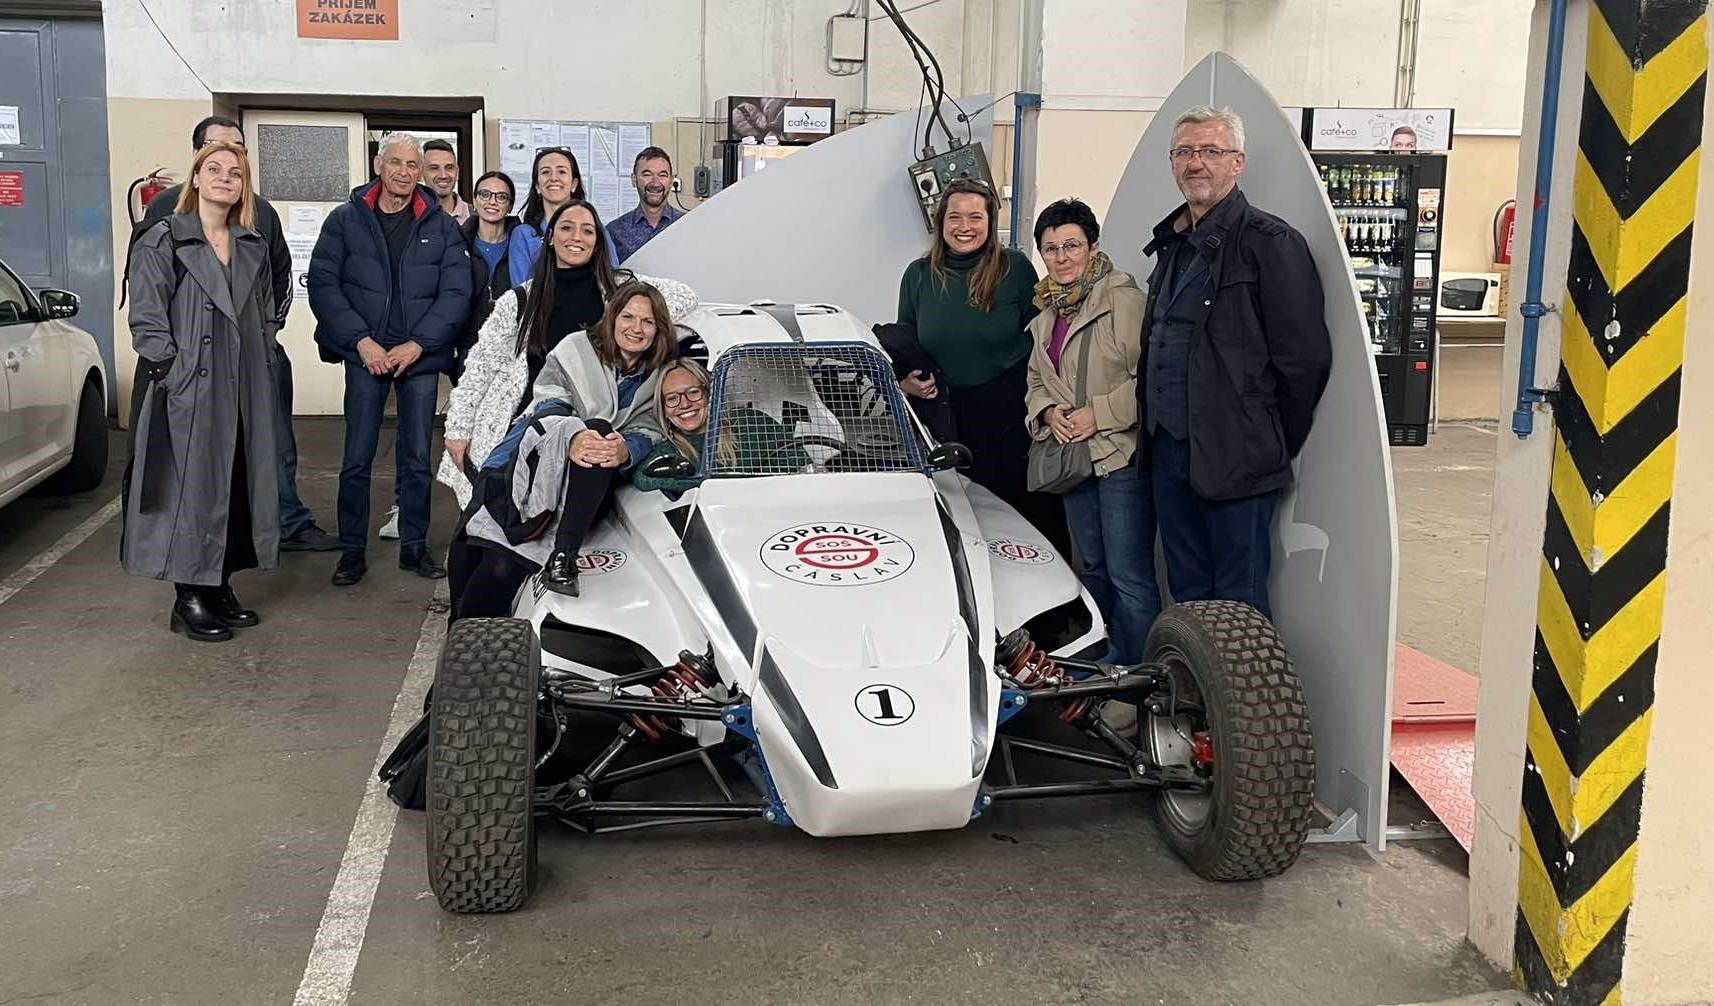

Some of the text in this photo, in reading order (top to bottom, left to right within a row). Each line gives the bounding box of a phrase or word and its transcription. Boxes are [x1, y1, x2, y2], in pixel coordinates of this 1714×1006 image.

[308, 10, 386, 24] ZAKÁZEK
[816, 540, 851, 548] SOS
[821, 554, 858, 562] SOU
[868, 688, 903, 719] 1
